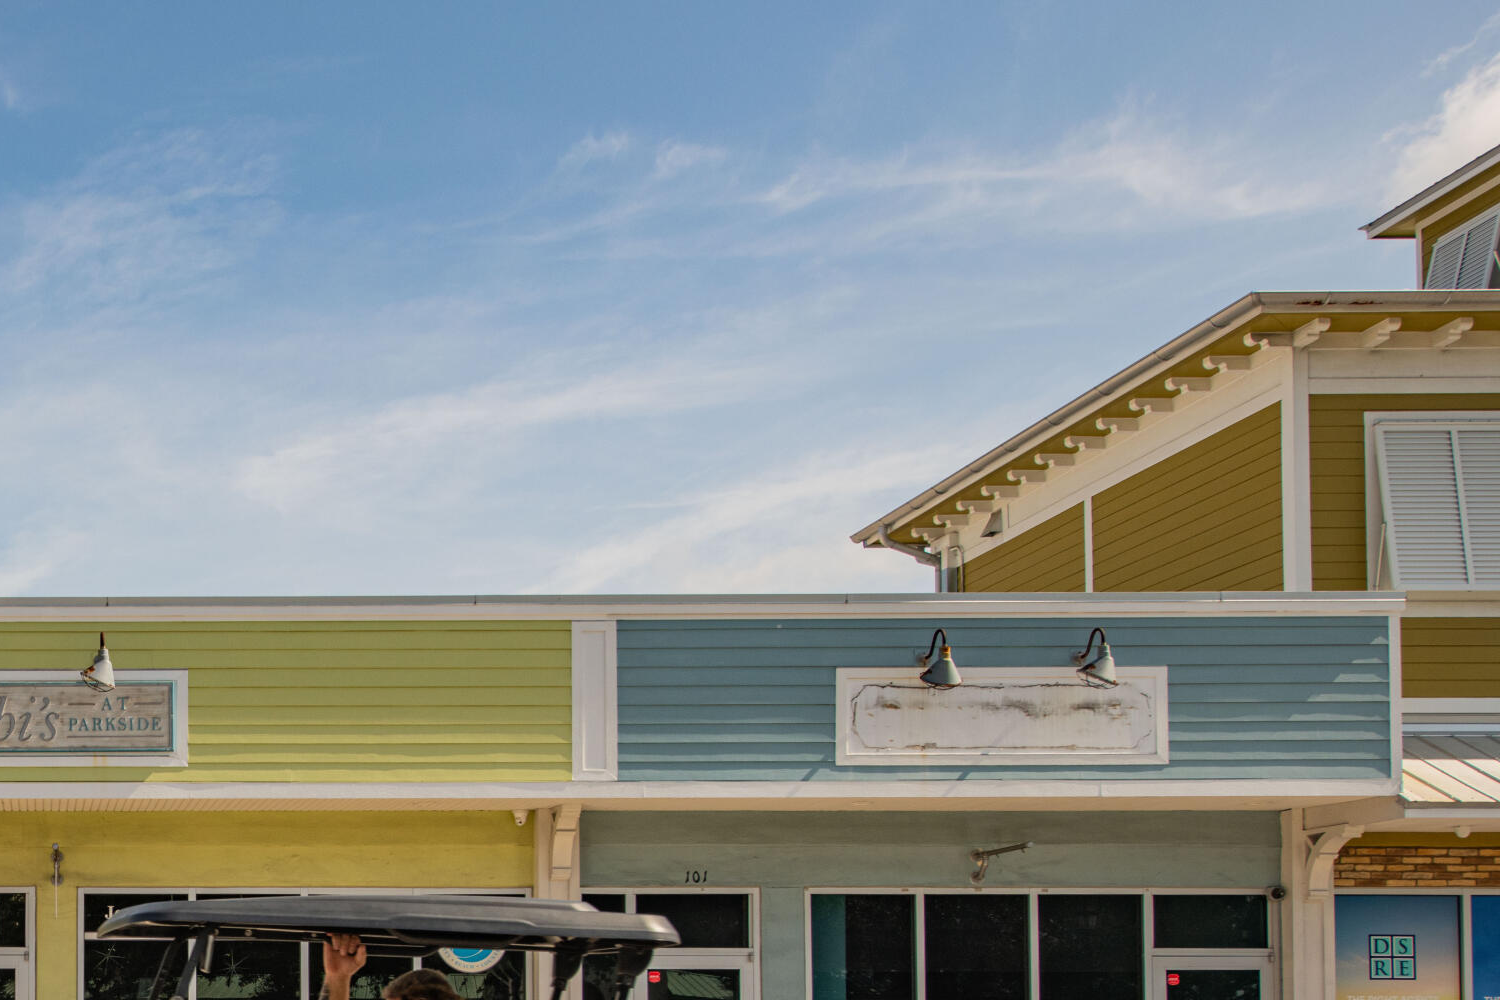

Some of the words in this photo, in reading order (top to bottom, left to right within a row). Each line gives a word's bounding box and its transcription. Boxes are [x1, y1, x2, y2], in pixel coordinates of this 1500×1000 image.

[102, 696, 130, 712] AT
[68, 717, 162, 732] PARKSIDE
[685, 870, 708, 883] 101
